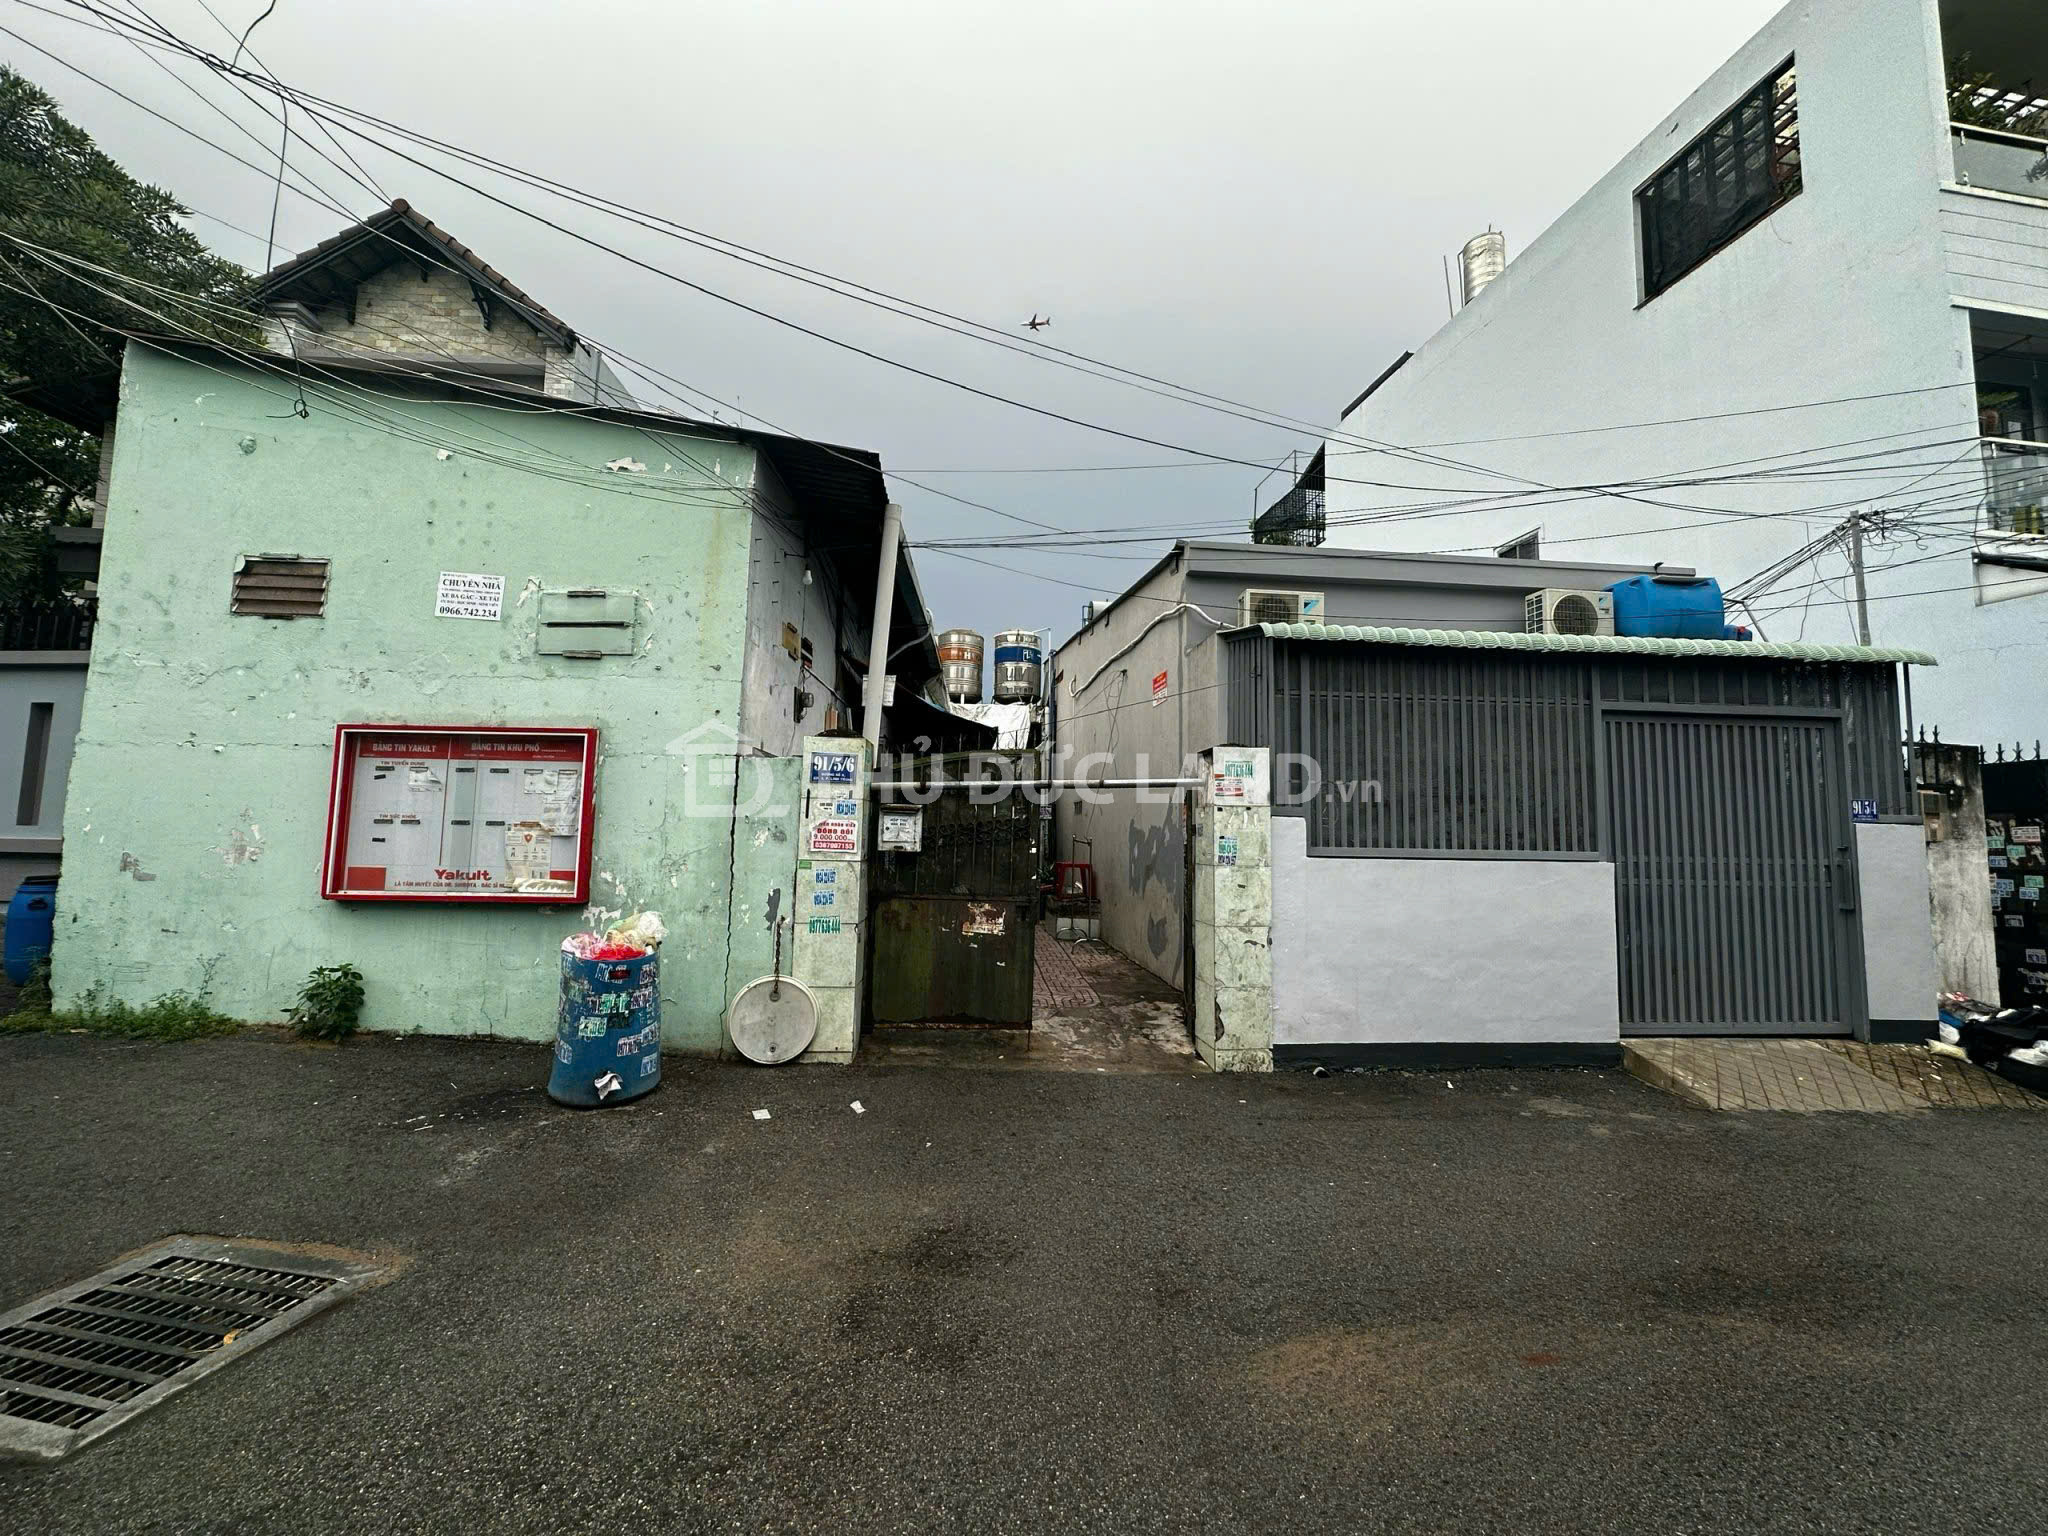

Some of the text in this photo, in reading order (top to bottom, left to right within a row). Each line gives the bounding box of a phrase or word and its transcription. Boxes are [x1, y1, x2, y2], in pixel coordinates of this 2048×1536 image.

[482, 581, 501, 590] NHÀ
[440, 606, 497, 618] 0966.742.234
[394, 744, 407, 752] TIN
[408, 744, 437, 753] YAKULT
[494, 743, 506, 751] TIN
[507, 744, 523, 752] KHU
[813, 755, 855, 772] 91/5/6
[434, 869, 493, 881] Yakult
